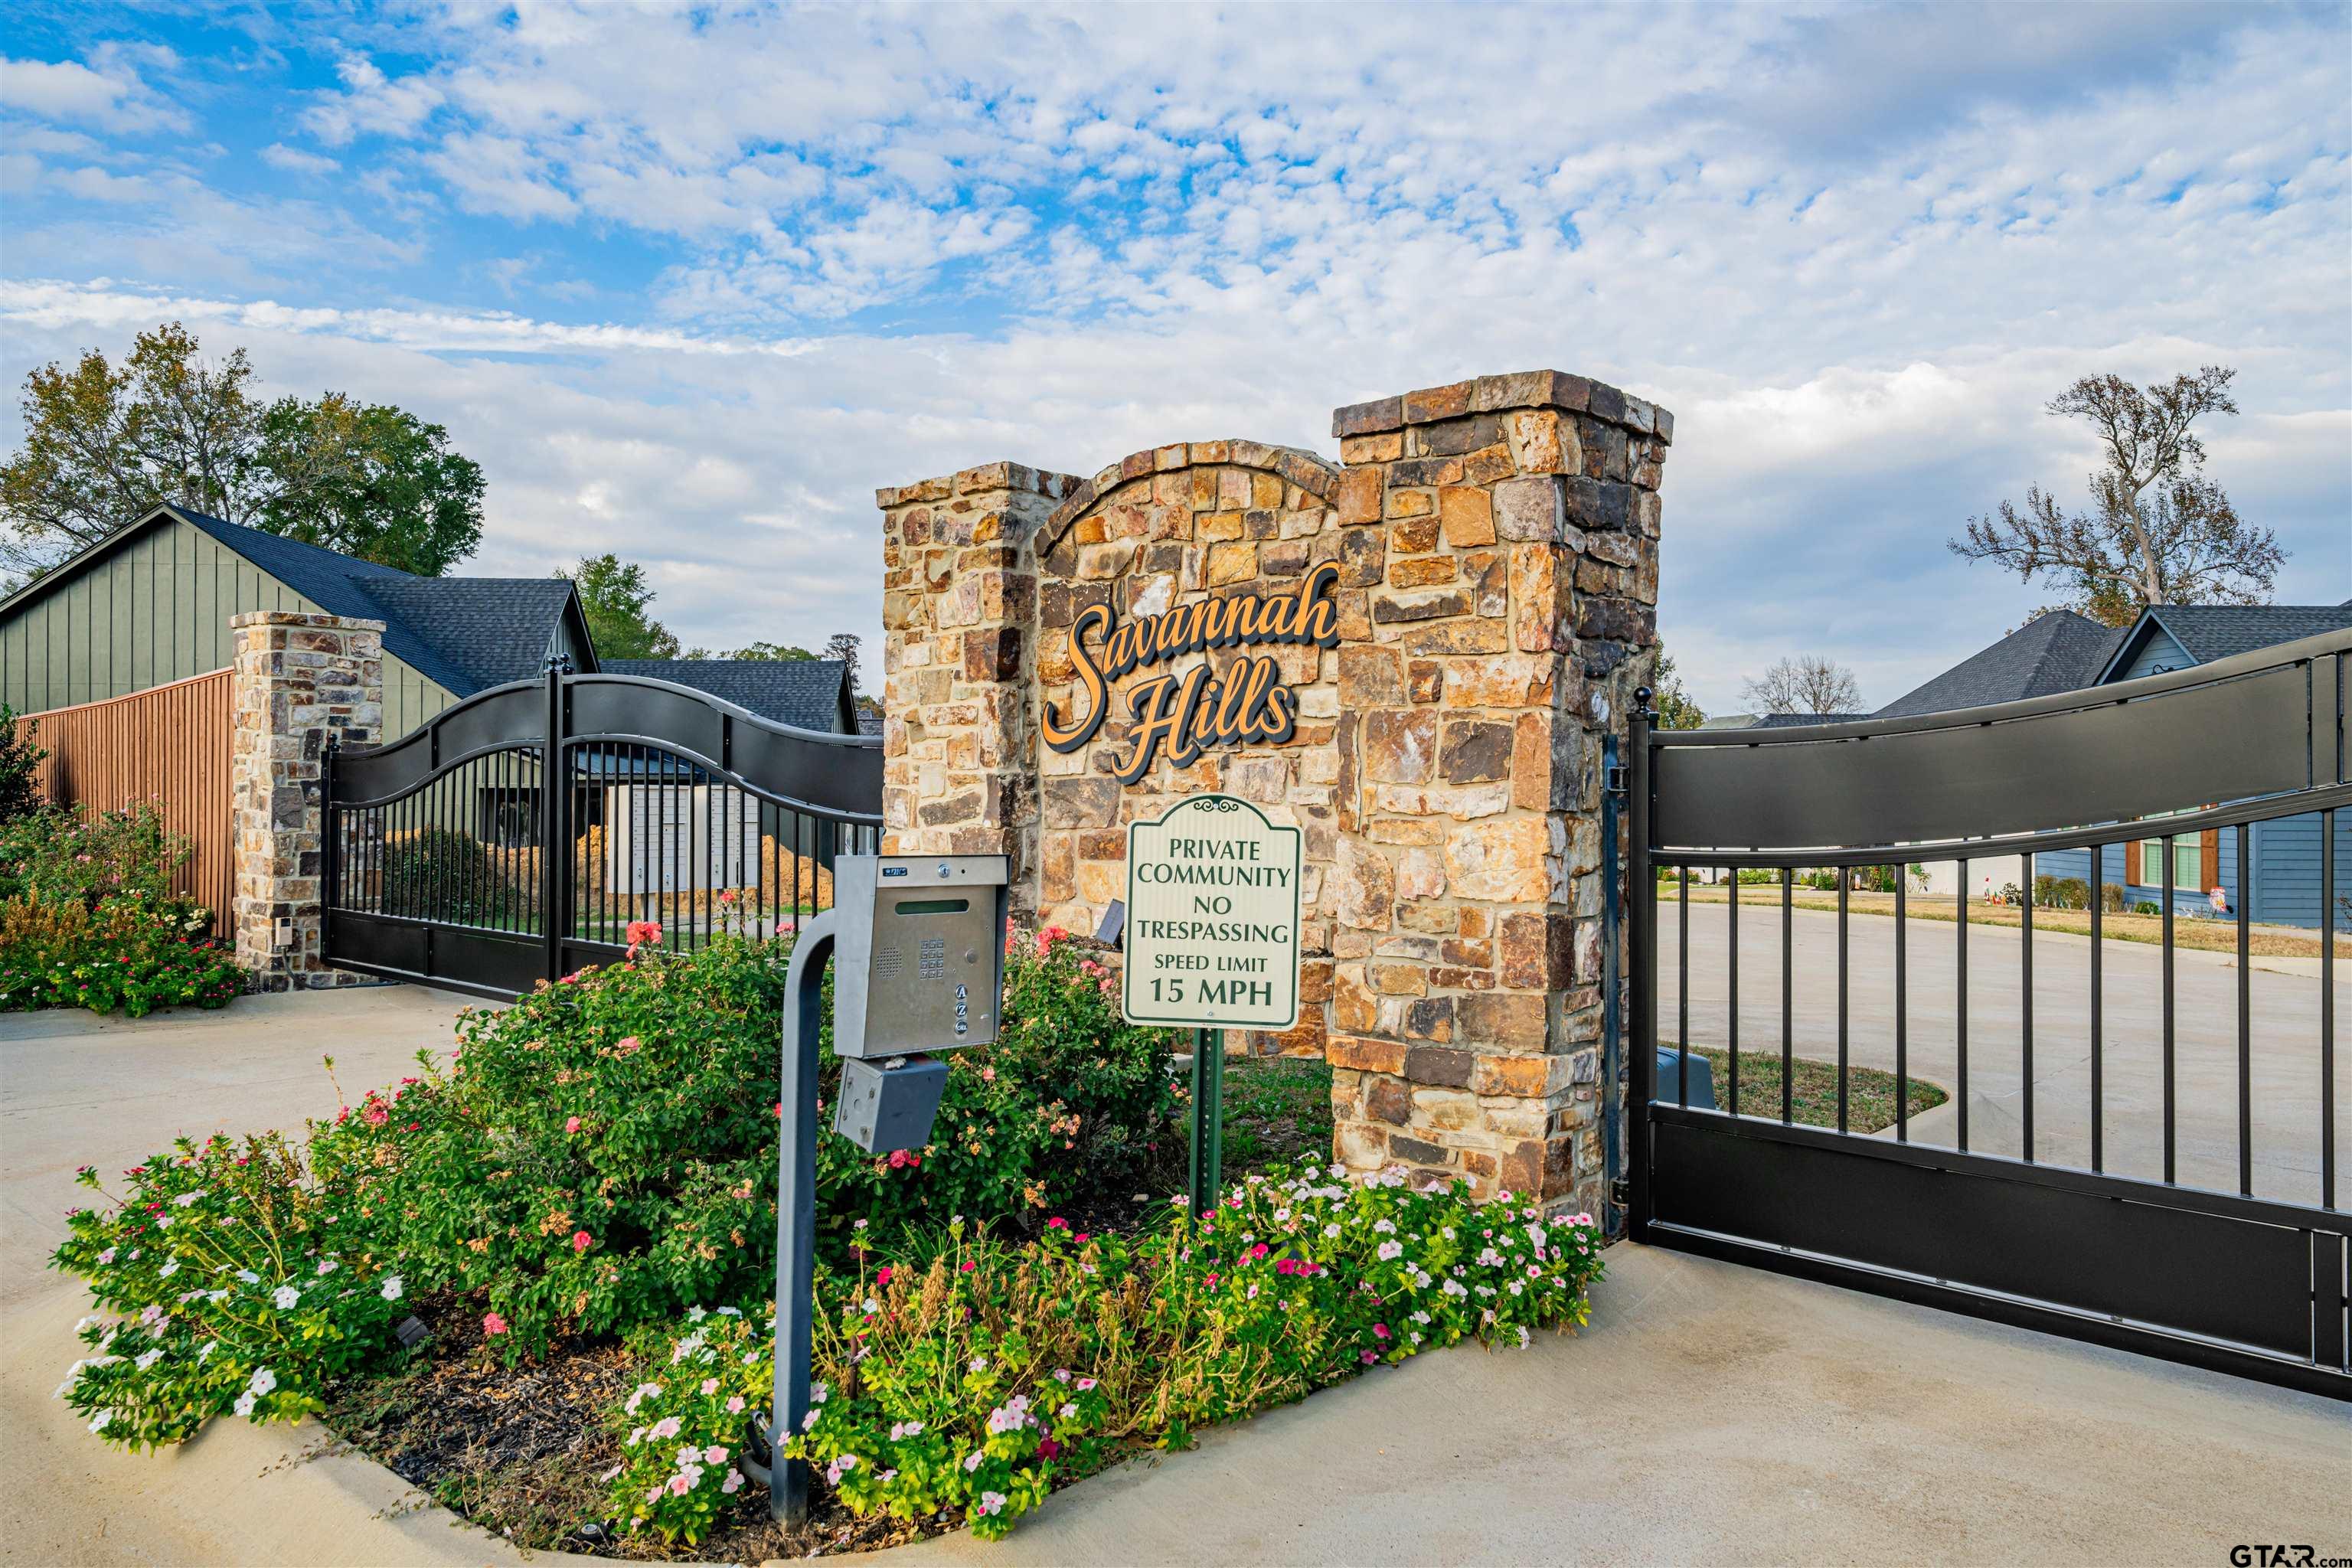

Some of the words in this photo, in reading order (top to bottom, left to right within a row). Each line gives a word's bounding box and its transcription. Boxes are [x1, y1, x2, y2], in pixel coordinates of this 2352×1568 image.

[1041, 558, 1339, 753] Savannah
[1111, 655, 1295, 786] Hills
[1169, 838, 1260, 861] PRIVATE
[1137, 863, 1291, 887] COMMUNITY
[1194, 896, 1232, 915] NO
[1137, 920, 1289, 943] TRESPASSING
[1154, 954, 1210, 971] SPEED
[1217, 956, 1268, 972] LIMIT
[958, 986, 967, 998] A
[1150, 978, 1184, 1002] 15
[1197, 979, 1272, 1006] MPH
[958, 1004, 967, 1015] Z
